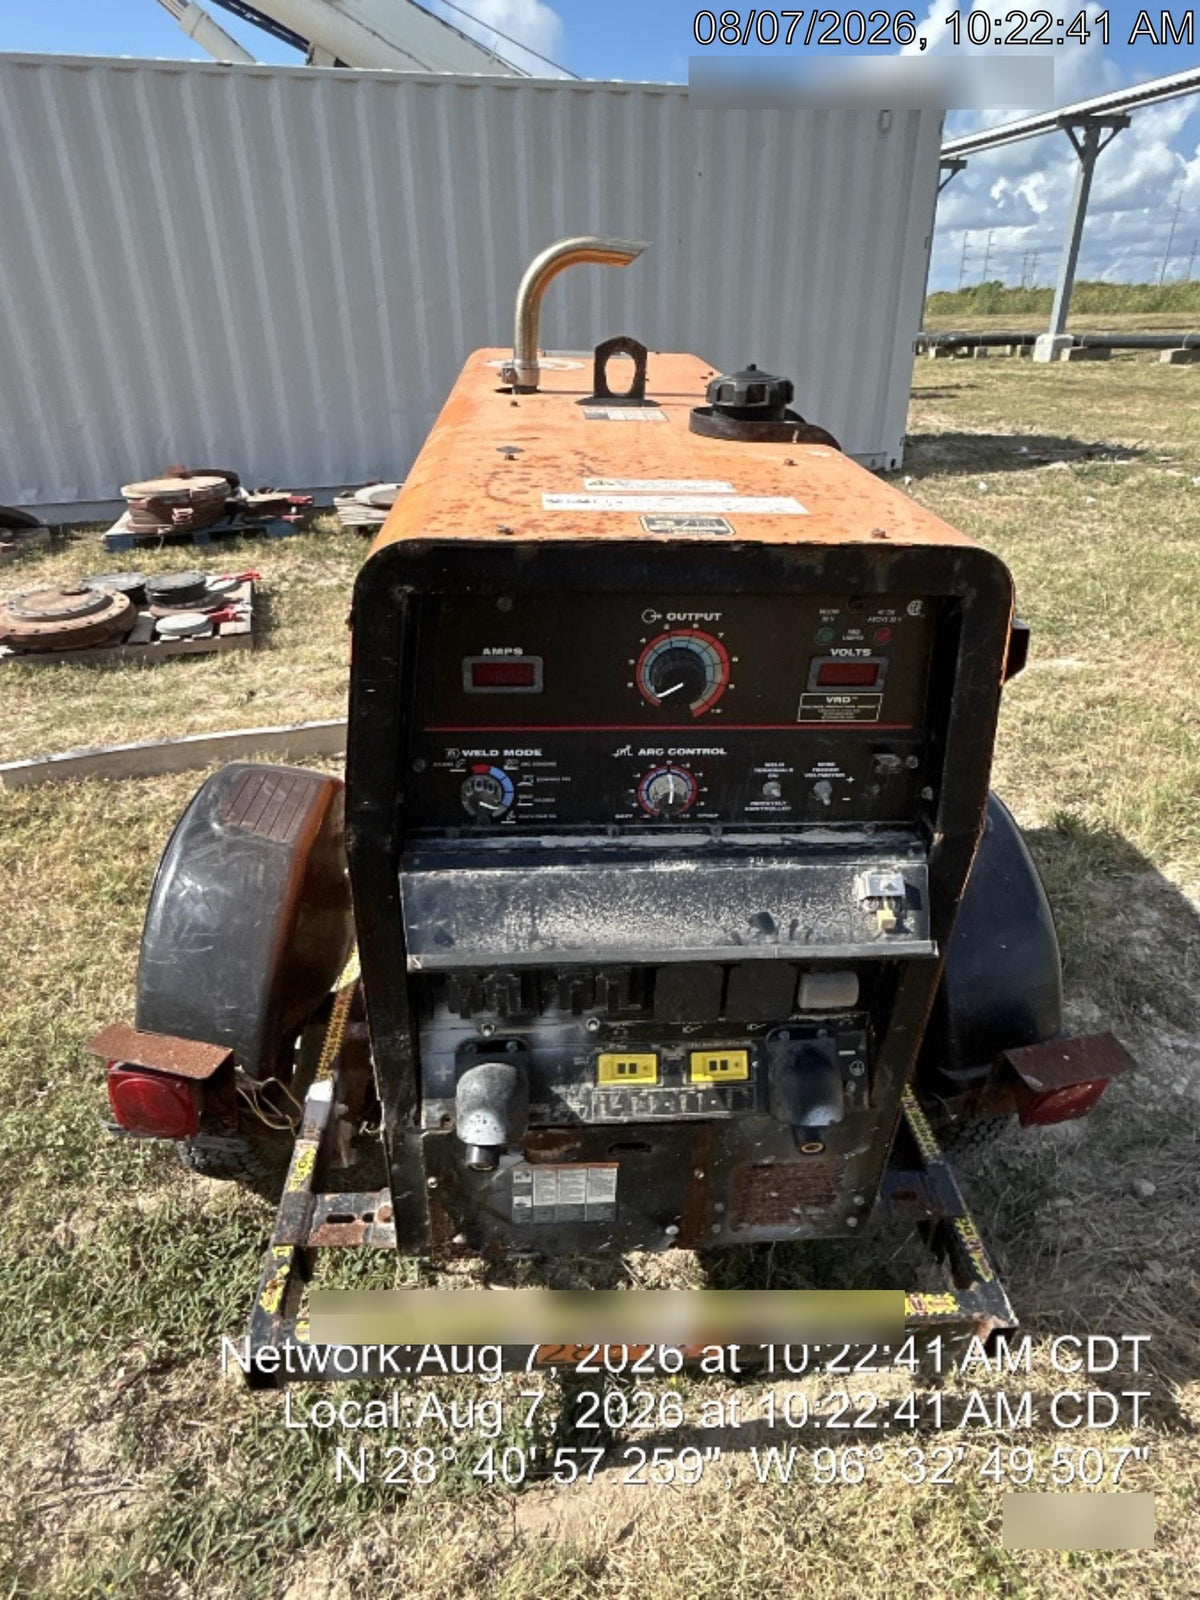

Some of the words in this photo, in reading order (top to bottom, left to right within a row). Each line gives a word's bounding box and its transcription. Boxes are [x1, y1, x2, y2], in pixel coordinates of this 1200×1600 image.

[666, 612, 722, 621] OUTPUT
[482, 647, 523, 656] AMPS
[830, 648, 872, 656] VOLTS
[462, 749, 499, 757] WELD
[503, 748, 543, 757] MODE
[638, 748, 664, 756] ARC
[668, 747, 728, 755] CONTROL
